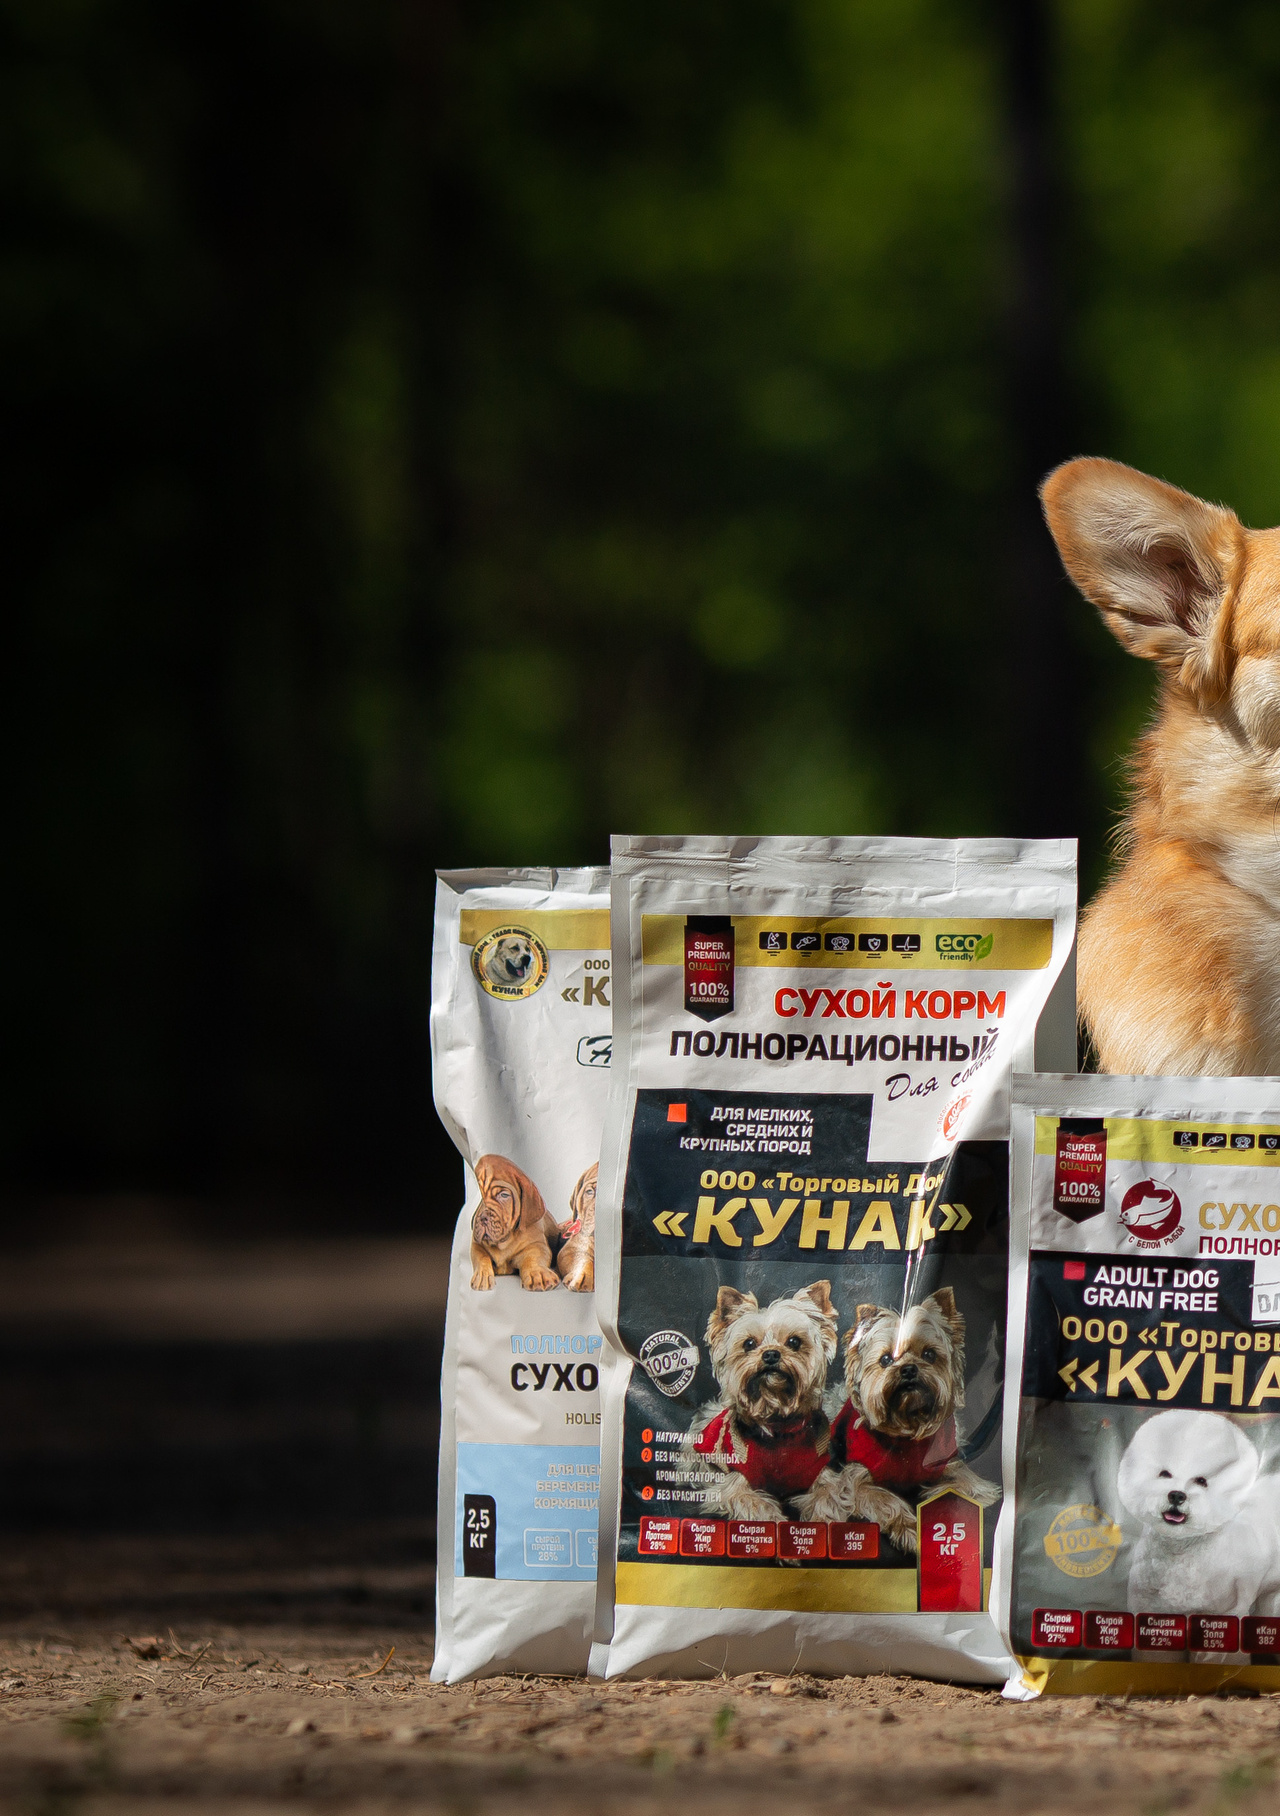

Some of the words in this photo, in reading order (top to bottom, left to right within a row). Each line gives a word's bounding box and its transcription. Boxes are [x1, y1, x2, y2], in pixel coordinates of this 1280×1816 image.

[694, 941, 724, 950] SUPER
[939, 936, 977, 951] eco
[687, 951, 730, 959] PREMIUM
[939, 952, 973, 962] friendly
[584, 959, 610, 970] ООО
[688, 962, 730, 971] QUALITY
[492, 985, 523, 995] КУНАК
[690, 982, 729, 996] 100%
[689, 996, 729, 1004] GUARANTEED
[775, 981, 896, 1019] СУХОЙ
[904, 989, 1006, 1019] КОРМ
[669, 1027, 1000, 1066] ПОЛНОРАЦИОННЫЙ
[885, 1072, 939, 1102] Для
[710, 1107, 745, 1122] ДЛЯ
[747, 1107, 814, 1124] МЕЛКИХ,
[726, 1123, 799, 1139] СРЕДНИХ
[679, 1136, 756, 1152] КРУПНЫХ
[757, 1138, 811, 1154] ПОРОД
[1066, 1143, 1096, 1152] SUPER
[1059, 1151, 1102, 1161] PREMIUM
[1059, 1161, 1102, 1173] QUALITY
[700, 1169, 756, 1190] ООО
[762, 1172, 899, 1197] «Торговый
[1060, 1181, 1100, 1197] 100%
[1059, 1196, 1100, 1204] GUARANTEED
[652, 1195, 973, 1250] «КУНАК»
[1136, 1239, 1161, 1249] БЕЛОЙ
[1163, 1225, 1186, 1246] РЫБОЙ
[1093, 1265, 1168, 1287] ADULT
[1173, 1269, 1219, 1289] DOG
[1083, 1287, 1153, 1309] GRAIN
[1159, 1292, 1218, 1312] FREE
[1062, 1316, 1128, 1345] ООО
[644, 1334, 681, 1353] NATURAL
[647, 1352, 688, 1376] 100%
[655, 1431, 704, 1444] НАТУРАЛЬНО
[655, 1450, 668, 1461] БЕЗ
[669, 1451, 740, 1464] ИСКУССТВЕННЫХ
[547, 1463, 574, 1477] ДЛЯ
[656, 1470, 725, 1482] АРОМАТИЗАТОРОВ
[656, 1489, 671, 1500] БЕЗ
[671, 1489, 722, 1502] КРАСИТЕЛЕЙ
[467, 1508, 490, 1531] 2,5
[648, 1521, 671, 1531] Сырой
[690, 1522, 716, 1533] Сырой
[739, 1524, 765, 1535] Сырая
[789, 1526, 816, 1537] Сырая
[645, 1531, 672, 1541] Протеин
[694, 1533, 712, 1543] Жир
[844, 1532, 865, 1541] кКал
[932, 1522, 966, 1543] 2,5
[731, 1534, 773, 1543] Клетчатка
[793, 1536, 813, 1545] Зола
[650, 1541, 666, 1550] 28%
[694, 1544, 712, 1553] 16%
[745, 1545, 759, 1553] 5%
[797, 1546, 810, 1555] 7%
[846, 1542, 863, 1551] 395
[538, 1552, 558, 1561] 28%
[1044, 1612, 1071, 1624] Сырой
[1095, 1615, 1123, 1626] Сырой
[1147, 1617, 1175, 1627] Сырая
[1040, 1623, 1074, 1634] Протеин
[1200, 1620, 1228, 1630] Сырая
[1256, 1626, 1277, 1635] кКал
[1100, 1626, 1118, 1636] Жир
[1140, 1627, 1182, 1637] Клетчатка
[1203, 1630, 1224, 1639] Зола
[1047, 1634, 1066, 1643] 27%
[1100, 1636, 1118, 1645] 16%
[1258, 1636, 1275, 1645] 382
